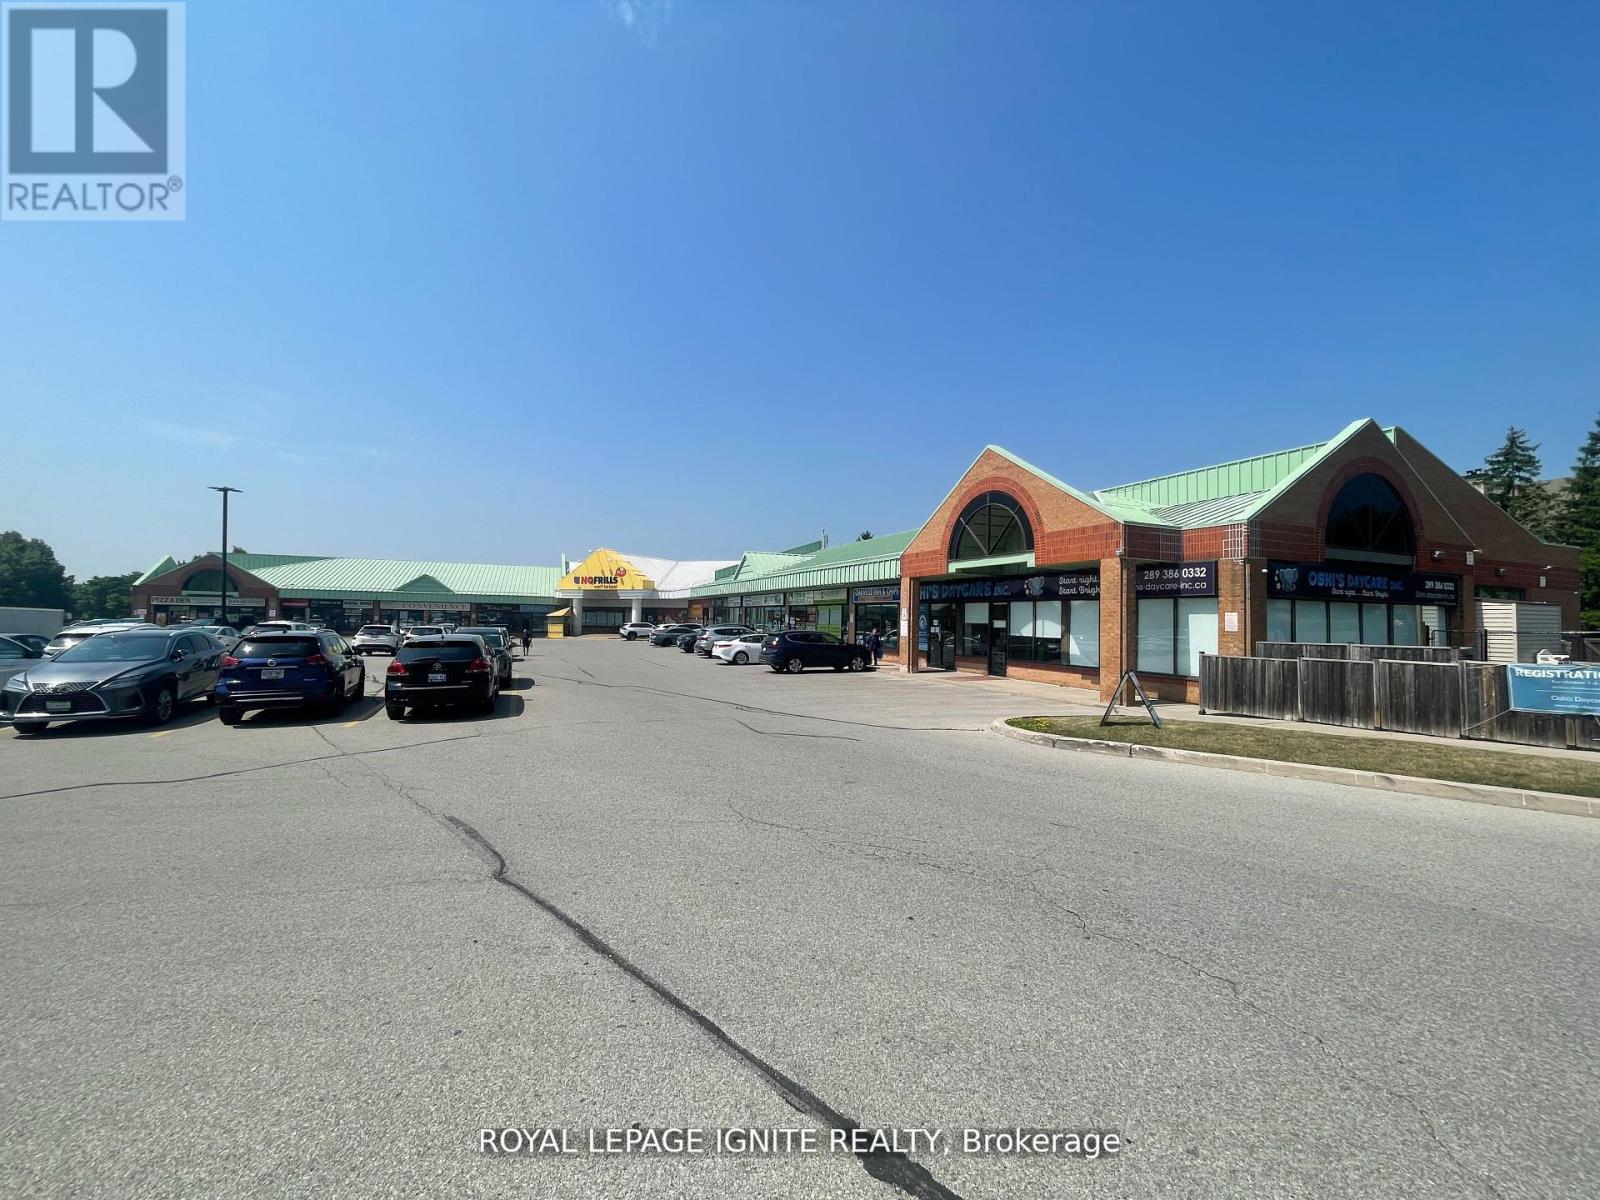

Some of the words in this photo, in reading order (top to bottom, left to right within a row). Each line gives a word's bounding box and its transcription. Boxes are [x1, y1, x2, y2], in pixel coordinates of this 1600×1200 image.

[1143, 570, 1160, 580] 289
[1162, 568, 1180, 579] 386
[1182, 567, 1207, 578] 0332
[1058, 576, 1078, 585] Start
[1308, 571, 1345, 588] OSHI'S
[1347, 573, 1389, 589] DAYCARE
[941, 581, 992, 599] DAYCARE
[1058, 586, 1078, 595] Start
[1078, 585, 1100, 596] Brigh
[401, 602, 466, 610] CONVENIENCE
